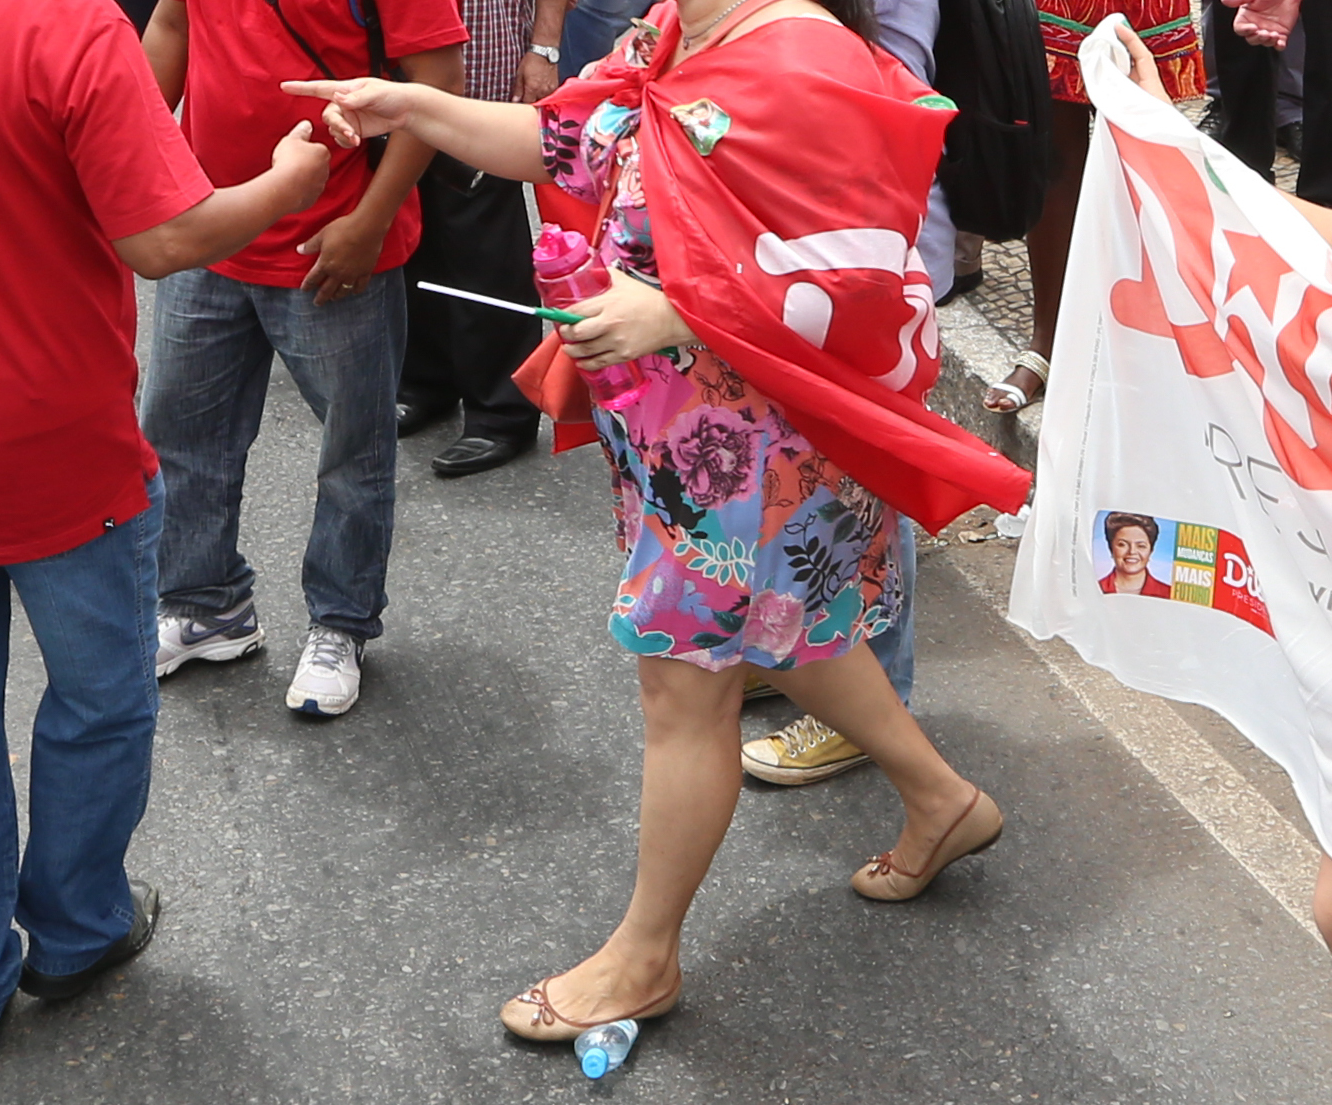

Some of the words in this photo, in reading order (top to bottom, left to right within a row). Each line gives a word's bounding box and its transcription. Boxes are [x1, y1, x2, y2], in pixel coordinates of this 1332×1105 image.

[1176, 523, 1216, 550] MAIS
[1176, 546, 1215, 564] MUDANÇAS
[1174, 565, 1213, 588] MAIS
[1173, 581, 1211, 606] FUTURO
